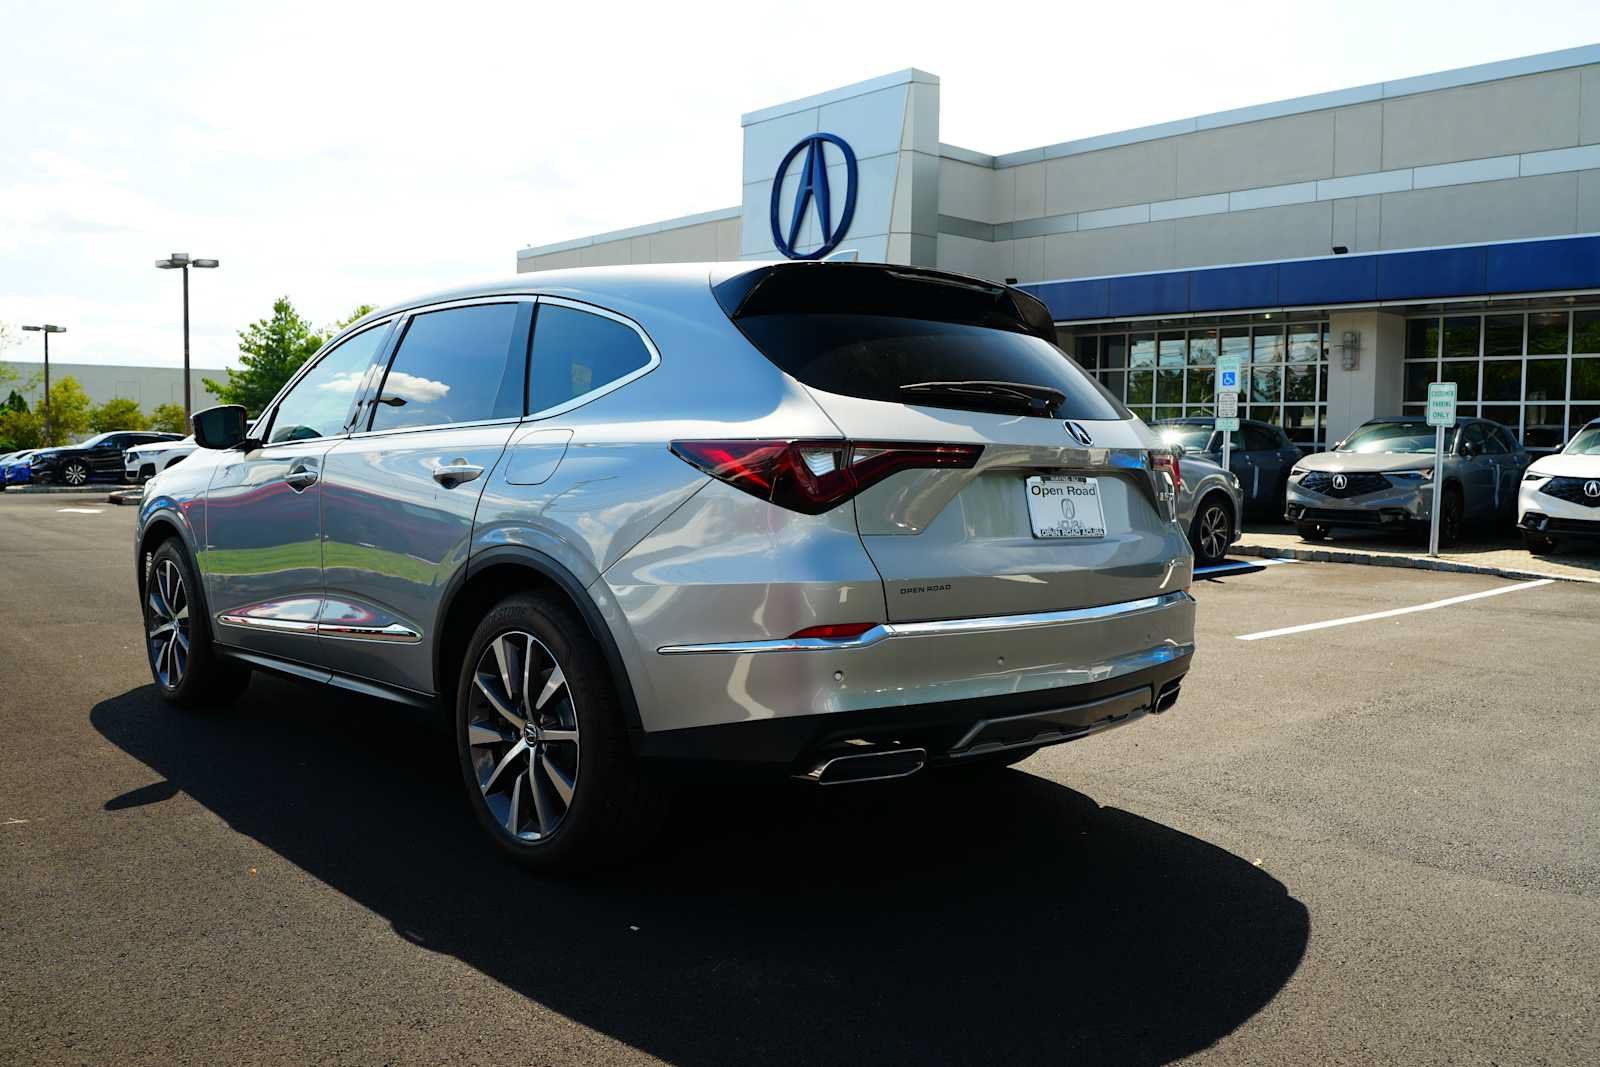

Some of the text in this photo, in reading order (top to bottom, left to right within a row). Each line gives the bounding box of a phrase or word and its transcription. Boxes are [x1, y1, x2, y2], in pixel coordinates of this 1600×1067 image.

[1031, 485, 1096, 497] Open Road
[1040, 528, 1105, 537] OPEN ROAD ACURA
[900, 584, 952, 595] OPEN ROAD
